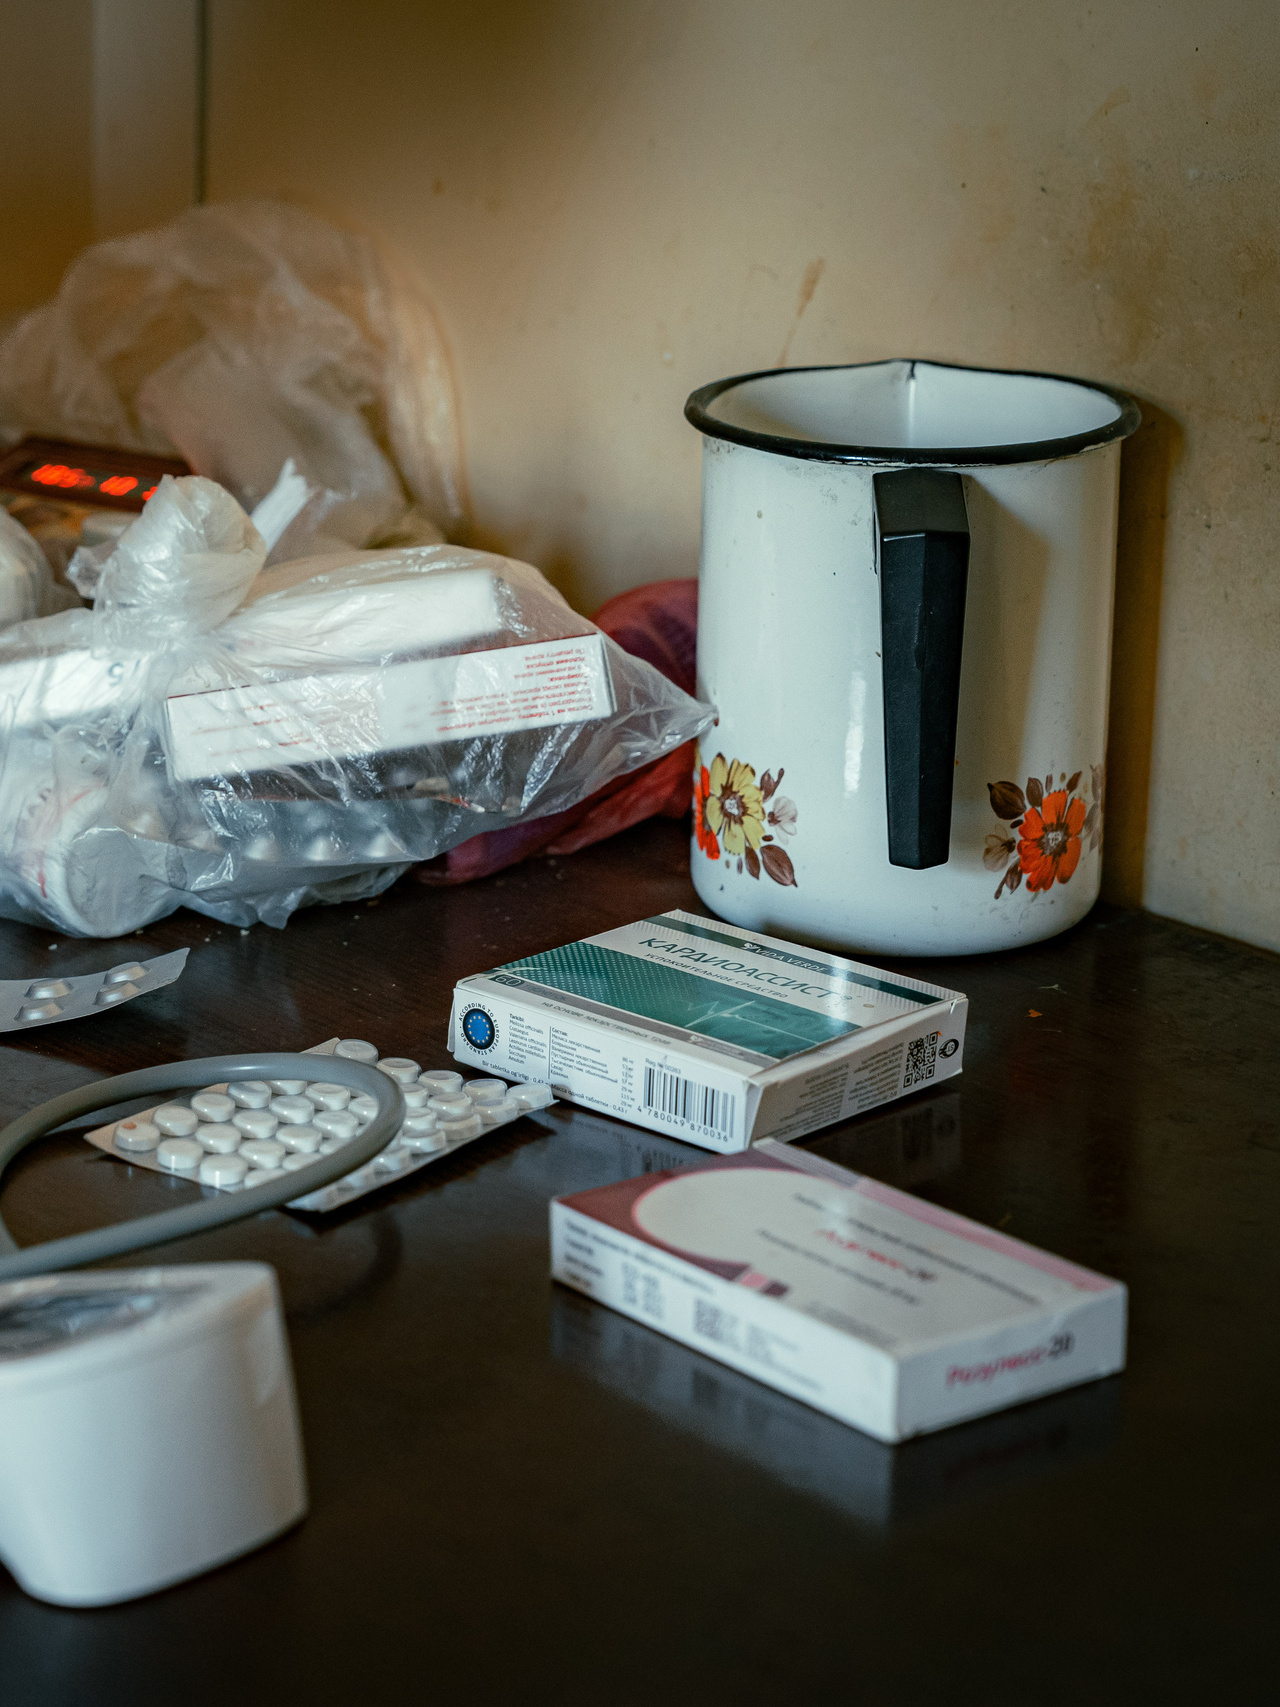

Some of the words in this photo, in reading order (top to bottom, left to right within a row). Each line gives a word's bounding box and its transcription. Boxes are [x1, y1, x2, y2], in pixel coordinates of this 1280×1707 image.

[638, 936, 841, 1000] КАРДИОАССИСТ
[754, 946, 786, 963] VIDA
[785, 956, 828, 974] VERDE
[494, 974, 522, 987] 60
[644, 952, 734, 984] УСПОКОИТЕЛЬНОЕ
[734, 978, 789, 999] СРЕДСТВО
[458, 1002, 486, 1022] ACCORDING
[487, 1008, 495, 1018] TO
[460, 1032, 488, 1056] STANDARD
[488, 1019, 501, 1054] EUROPEAN
[489, 1062, 510, 1075] tabletka
[551, 1083, 568, 1094] Масса
[567, 1090, 585, 1100] одной
[585, 1095, 609, 1108] таблетки
[612, 1105, 624, 1113] 0,43
[636, 1104, 642, 1113] 4
[647, 1108, 686, 1128] 780049
[689, 1123, 729, 1143] 870036
